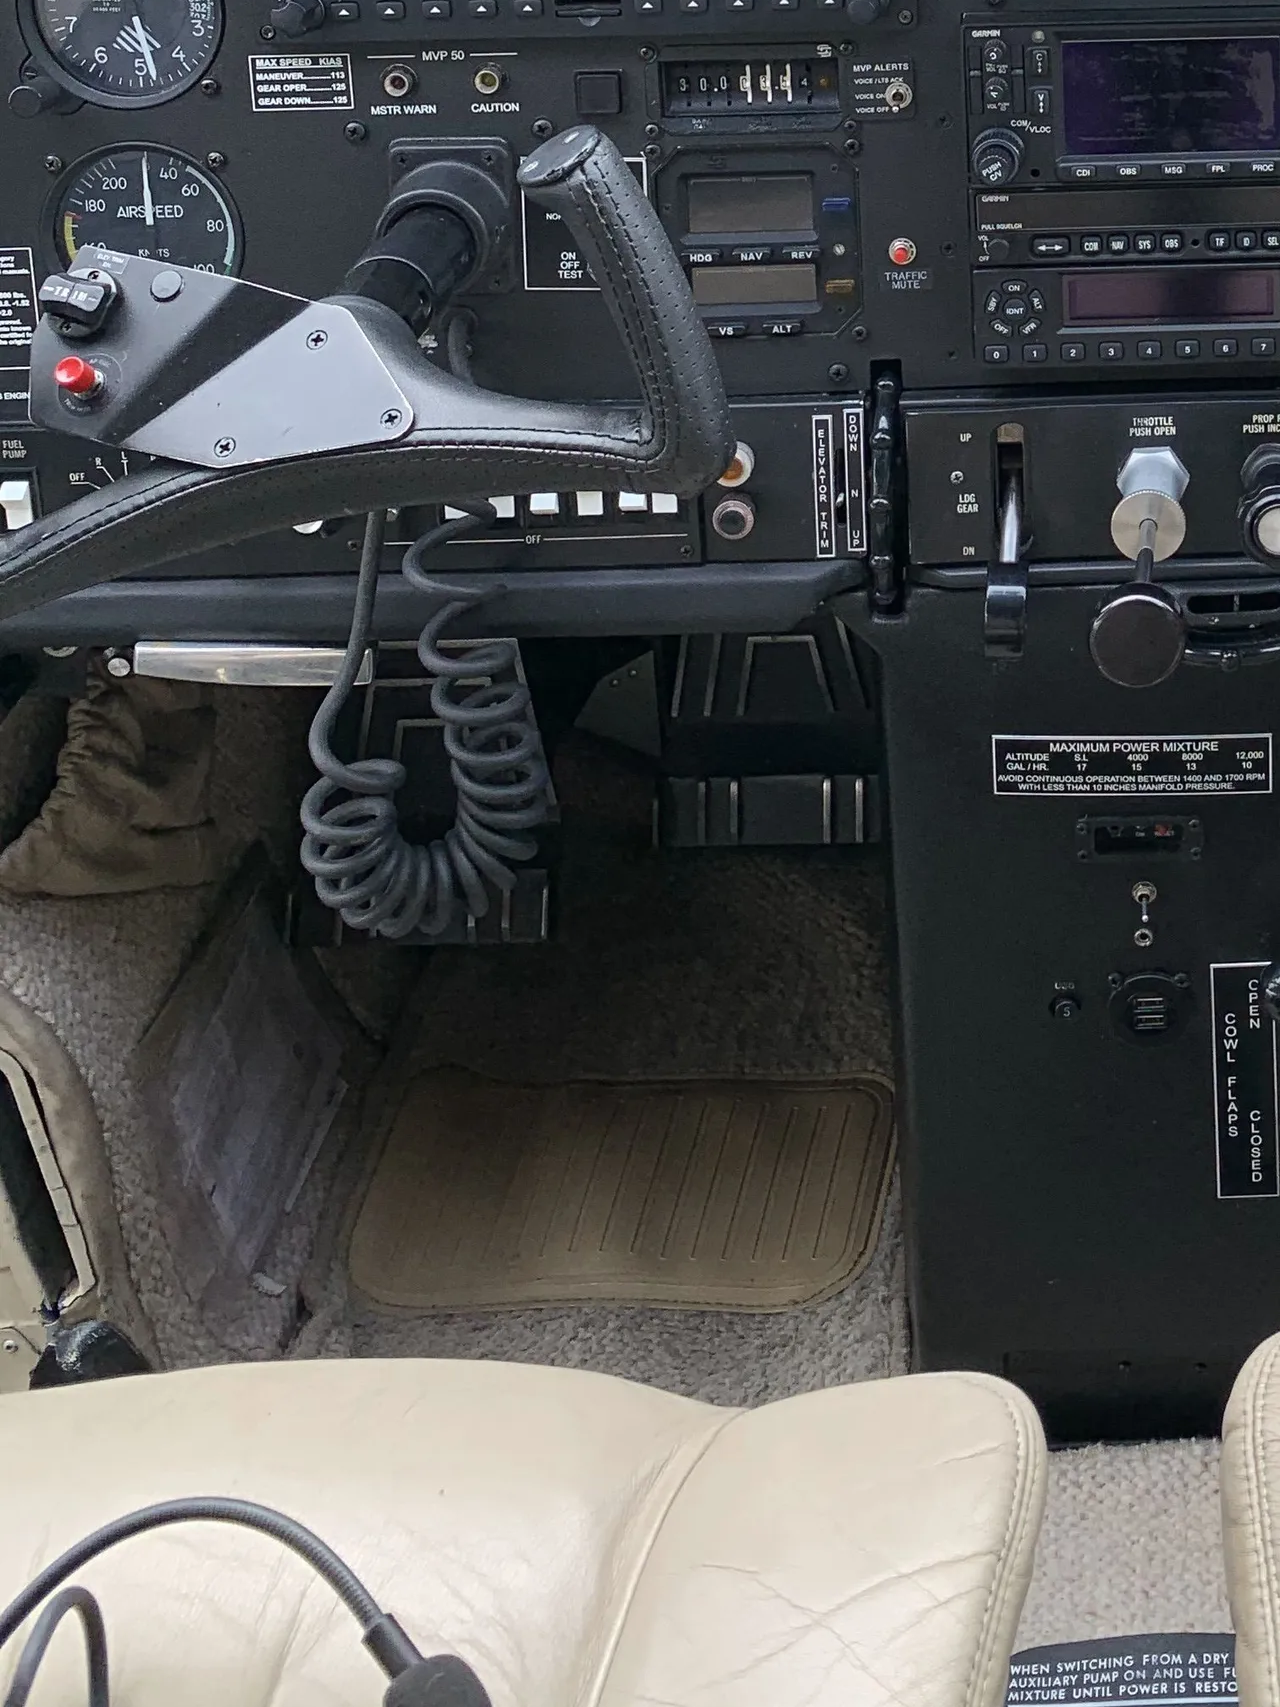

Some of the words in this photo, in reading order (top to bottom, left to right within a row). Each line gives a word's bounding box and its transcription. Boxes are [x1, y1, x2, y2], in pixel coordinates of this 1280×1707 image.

[422, 52, 447, 61] MVP
[451, 51, 464, 60] 50
[279, 58, 311, 66] SPEED
[320, 58, 343, 66] KIAS
[875, 63, 909, 71] ALERTS
[257, 84, 281, 92] GEAR
[258, 97, 283, 105] GEAR
[371, 106, 402, 115] MSTR
[404, 105, 436, 114] WARN
[471, 104, 519, 112] CAUTION
[160, 168, 177, 180] 40
[102, 178, 127, 190] 200
[182, 184, 199, 196] 60
[85, 200, 105, 212] 180
[207, 220, 224, 232] 80
[561, 252, 576, 260] ON
[689, 254, 712, 262] HDG
[741, 253, 762, 261] NAV
[791, 251, 812, 259] REV
[560, 261, 580, 269] OFF
[558, 270, 583, 278] TEST
[884, 271, 927, 281] TRAFFIC
[892, 280, 920, 289] MUTE
[719, 327, 734, 335] VS
[772, 326, 792, 334] ALT
[1132, 416, 1173, 426] THROTTLE
[1252, 415, 1273, 424] PROP
[1130, 427, 1152, 436] PUSH
[1154, 426, 1176, 435] OPEN
[1243, 424, 1266, 433] PUSH
[848, 415, 858, 452] DOWN
[960, 433, 971, 442] UP
[3, 440, 24, 449] FUEL
[3, 450, 26, 458] PUMP
[818, 429, 828, 503] ELEVATOR
[70, 473, 84, 481] OFF
[959, 494, 976, 503] LDG
[957, 504, 978, 513] GEAR
[820, 512, 829, 548] TRIM
[526, 535, 541, 544] OFF
[963, 547, 974, 555] DN
[1050, 743, 1110, 752] MAXIMUM
[1113, 743, 1159, 752] POWER
[1163, 742, 1219, 751] MIXTURE
[1006, 753, 1049, 761] ALTITUDE
[1127, 753, 1148, 761] 4000
[1236, 752, 1264, 760] 12,000
[1138, 774, 1181, 782] BETWEEN
[1104, 783, 1136, 791] INCHES
[1223, 1014, 1238, 1063] COWL
[1227, 1077, 1238, 1137] FLAPS
[1250, 1110, 1262, 1182] CLOSED
[1011, 1664, 1050, 1676] WHEN
[1057, 1656, 1134, 1672] SWITCHING
[1143, 1654, 1182, 1665] FROM
[1188, 1654, 1198, 1664] A
[1203, 1653, 1230, 1664] DRY
[1009, 1675, 1077, 1688] AUXILIARY
[1083, 1672, 1119, 1684] PUMP
[1124, 1670, 1145, 1681] ON
[1154, 1668, 1184, 1680] AND
[1189, 1668, 1214, 1679] USE
[1008, 1689, 1065, 1701] MIXTURE
[1073, 1686, 1112, 1699] UNTIL
[1119, 1683, 1167, 1694] POWER
[1174, 1682, 1186, 1692] IS
